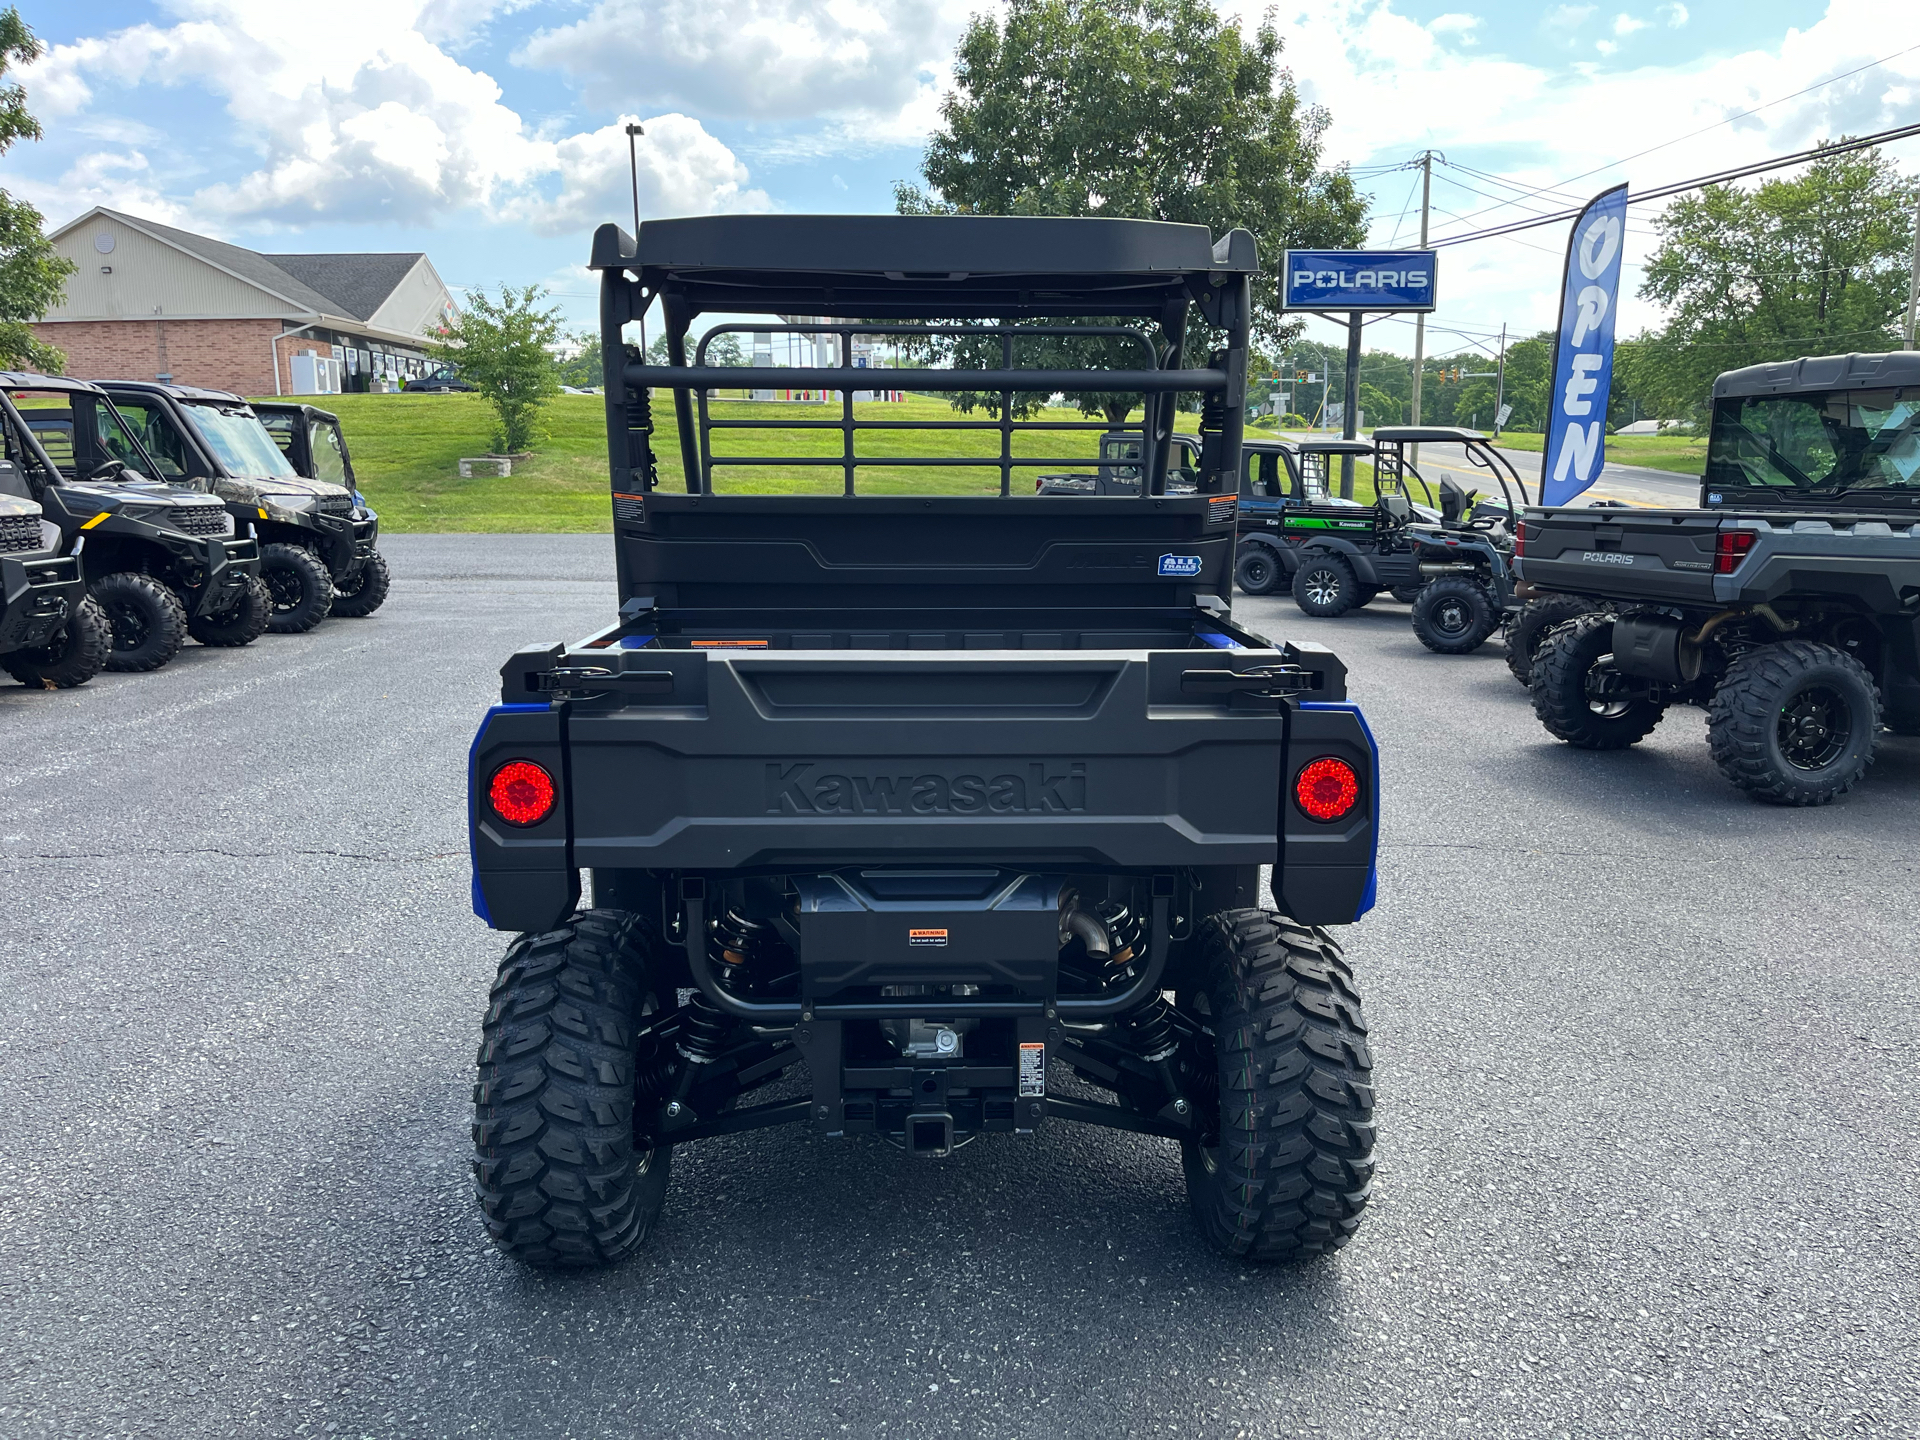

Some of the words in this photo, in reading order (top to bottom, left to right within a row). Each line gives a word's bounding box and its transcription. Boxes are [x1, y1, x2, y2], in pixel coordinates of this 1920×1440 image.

[1293, 270, 1428, 288] POLARIS
[1553, 215, 1620, 482] OPEN
[1582, 552, 1635, 565] POLARIS
[765, 762, 1087, 814] Kawasaki
